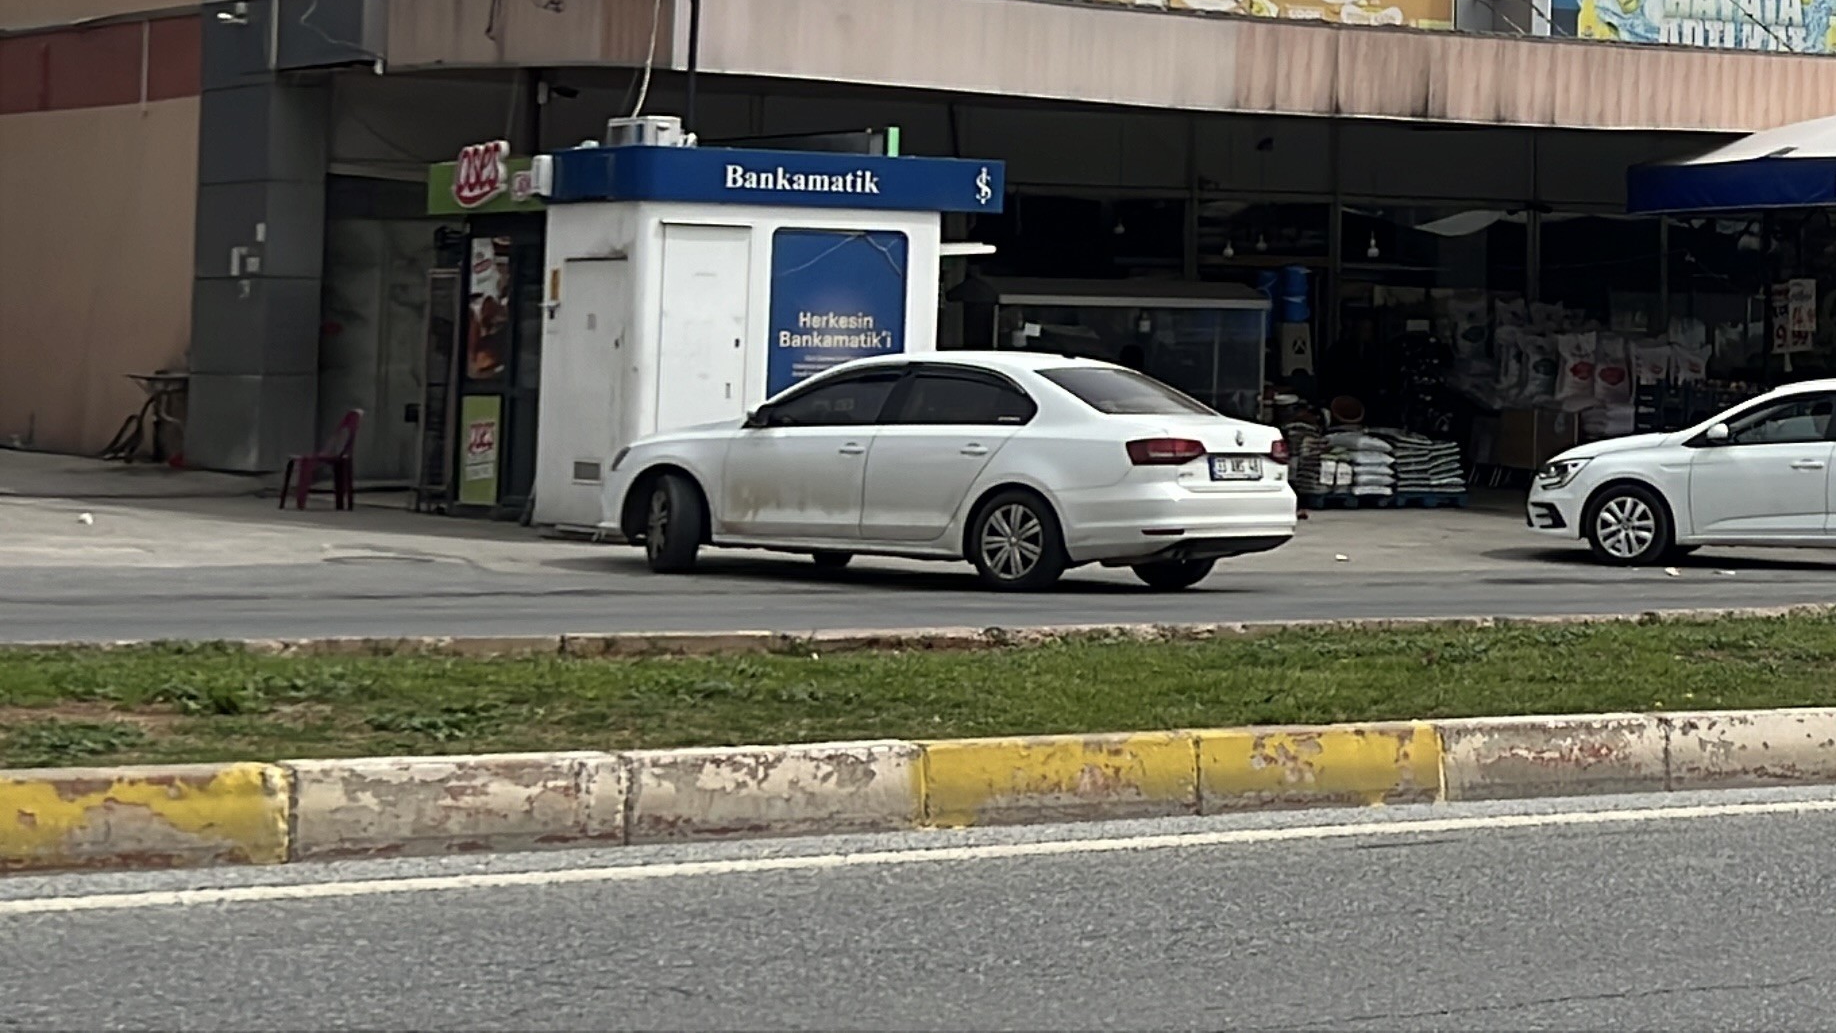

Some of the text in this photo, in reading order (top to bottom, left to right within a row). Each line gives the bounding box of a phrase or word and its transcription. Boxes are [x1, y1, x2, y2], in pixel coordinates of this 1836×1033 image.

[725, 165, 880, 195] Bankamatik
[799, 312, 874, 329] Herkesin
[779, 330, 892, 348] Bankamatik'i
